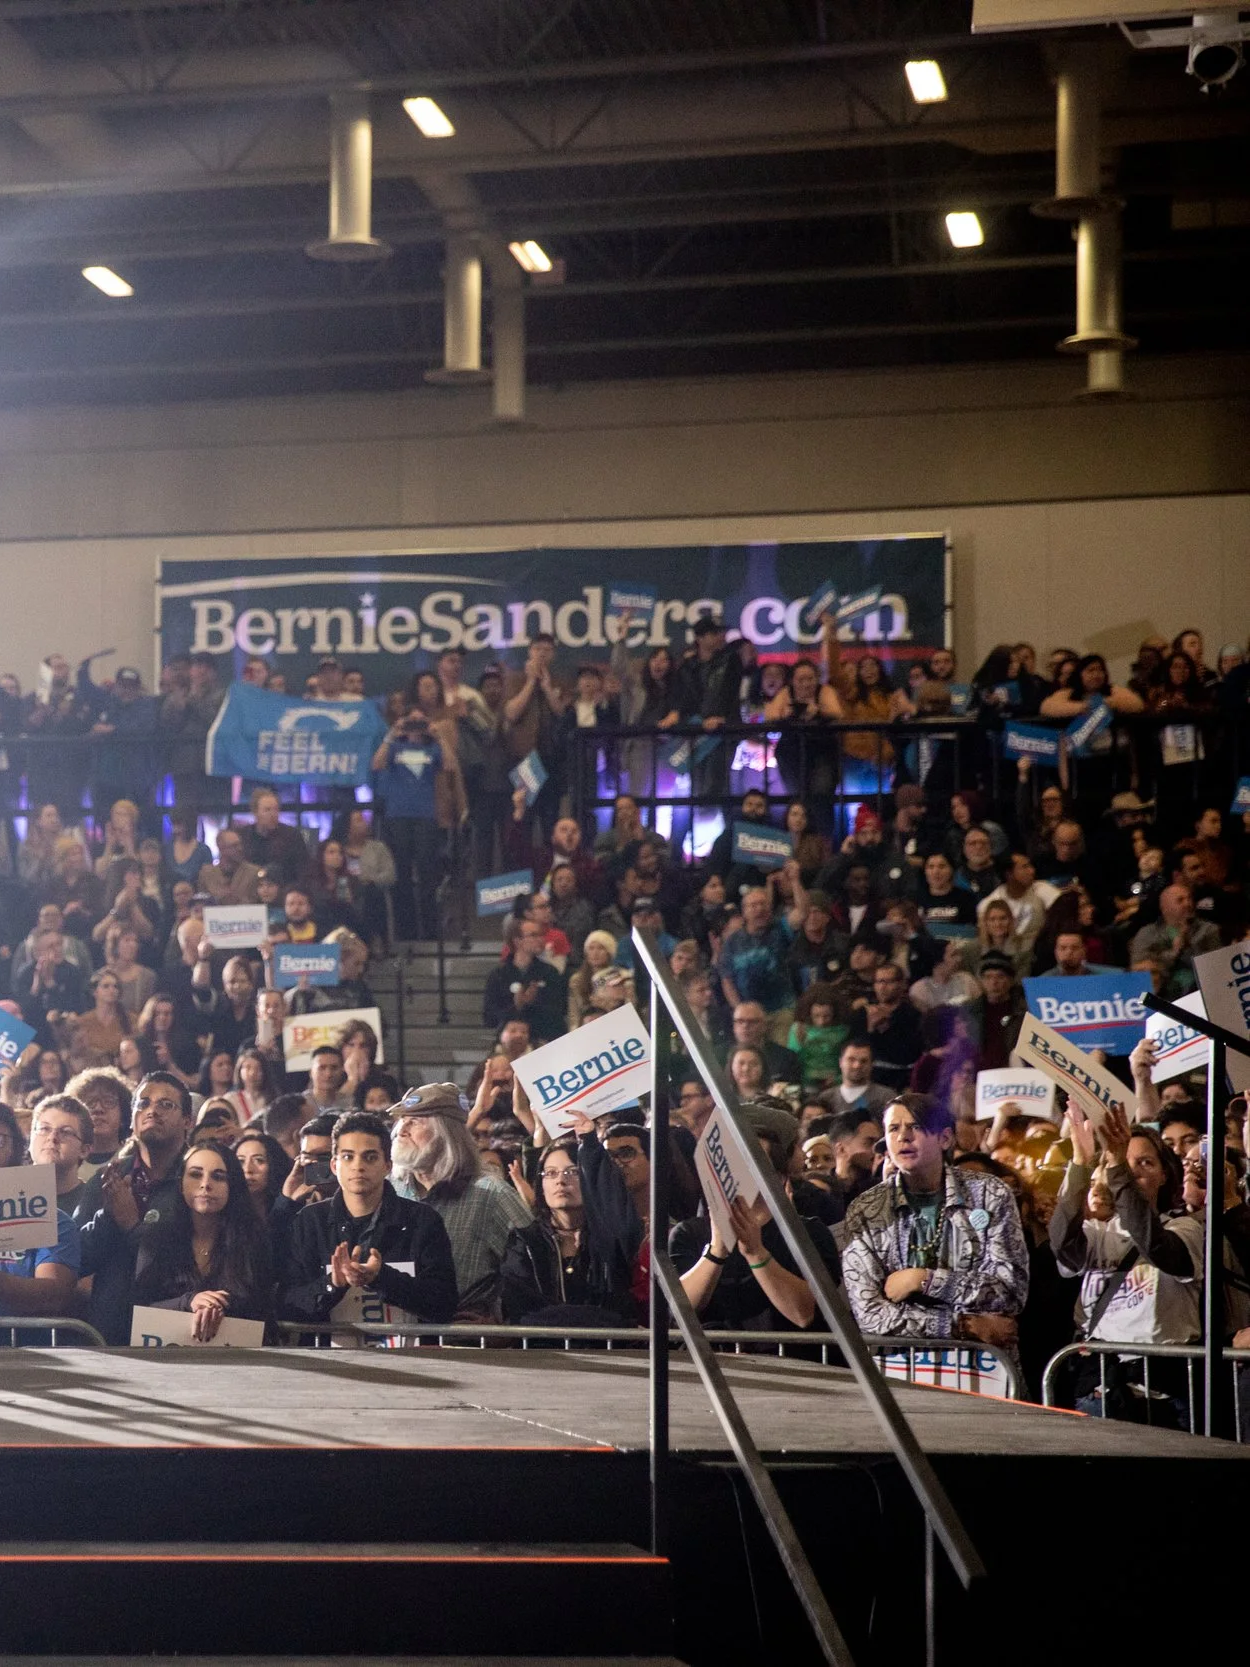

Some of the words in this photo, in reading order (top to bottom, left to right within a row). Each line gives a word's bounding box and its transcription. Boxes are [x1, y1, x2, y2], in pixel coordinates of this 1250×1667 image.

[258, 731, 325, 751] FEEL
[737, 832, 791, 857] Bernie
[209, 919, 262, 934] Bernie
[280, 955, 336, 973] Bernie
[1036, 993, 1147, 1023] Bernie
[533, 1037, 645, 1106] Bernie
[982, 1081, 1047, 1100] Bernie
[706, 1121, 738, 1203] Berni
